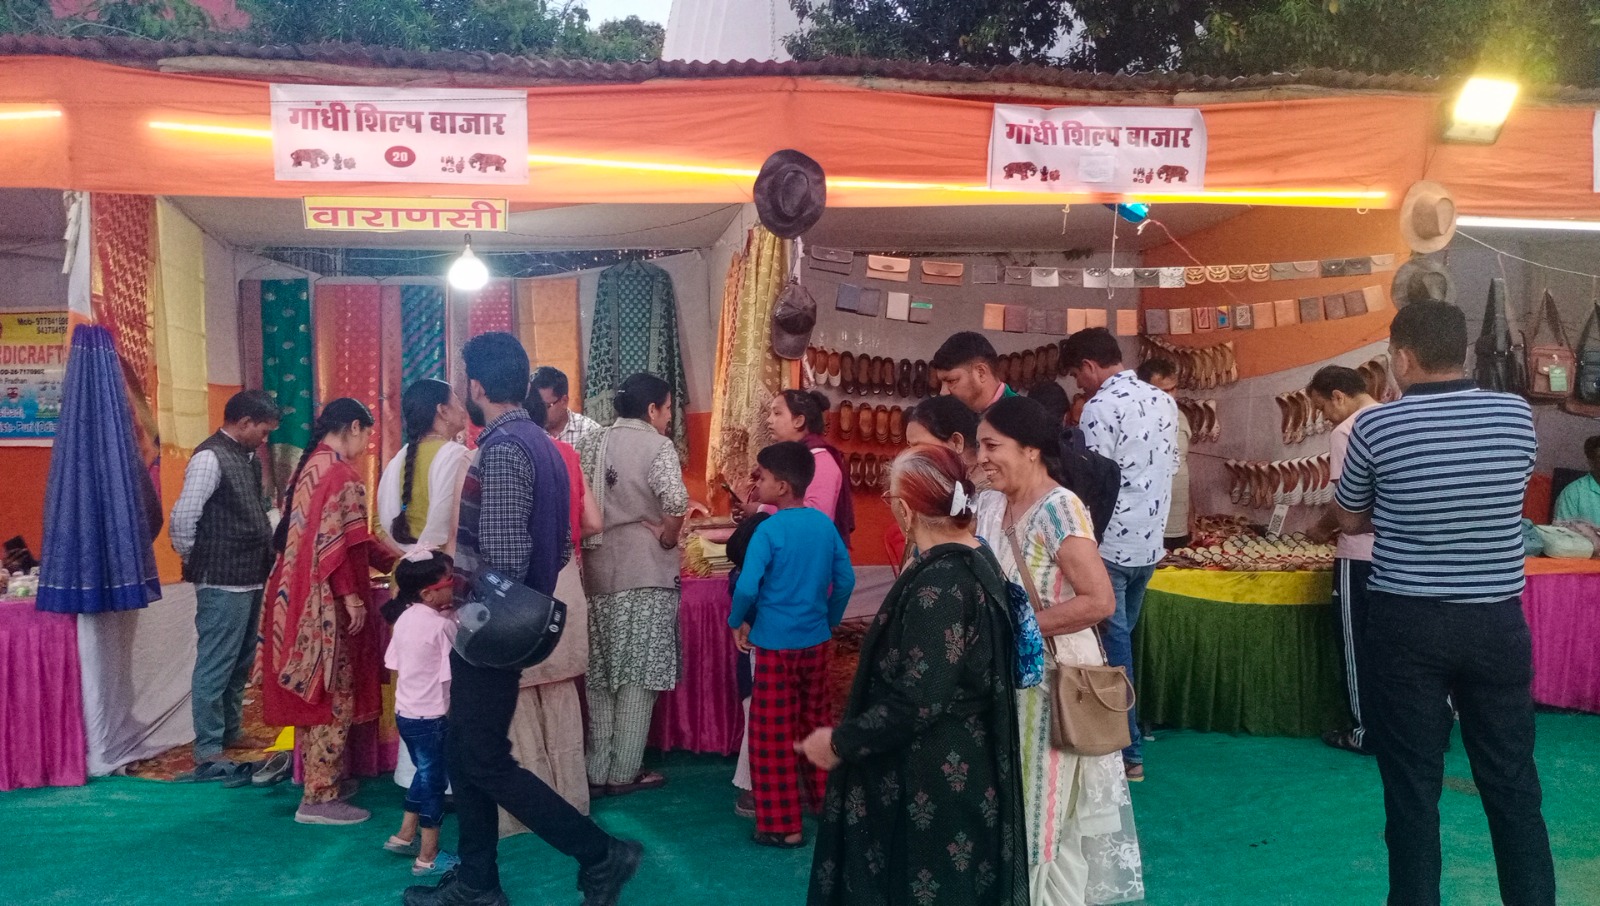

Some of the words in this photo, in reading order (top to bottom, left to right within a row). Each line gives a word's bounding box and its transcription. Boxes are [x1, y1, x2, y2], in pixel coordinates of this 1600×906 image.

[288, 101, 350, 132] गांधी
[354, 103, 424, 134] शिल्प
[429, 111, 507, 136] बाजार
[1005, 119, 1059, 145] गांधी
[1062, 120, 1122, 147] शिल्प
[1126, 127, 1194, 149] बाजार
[392, 151, 408, 162] 20
[308, 201, 502, 229] वाराणसी
[0, 344, 67, 365] DICRAFT
